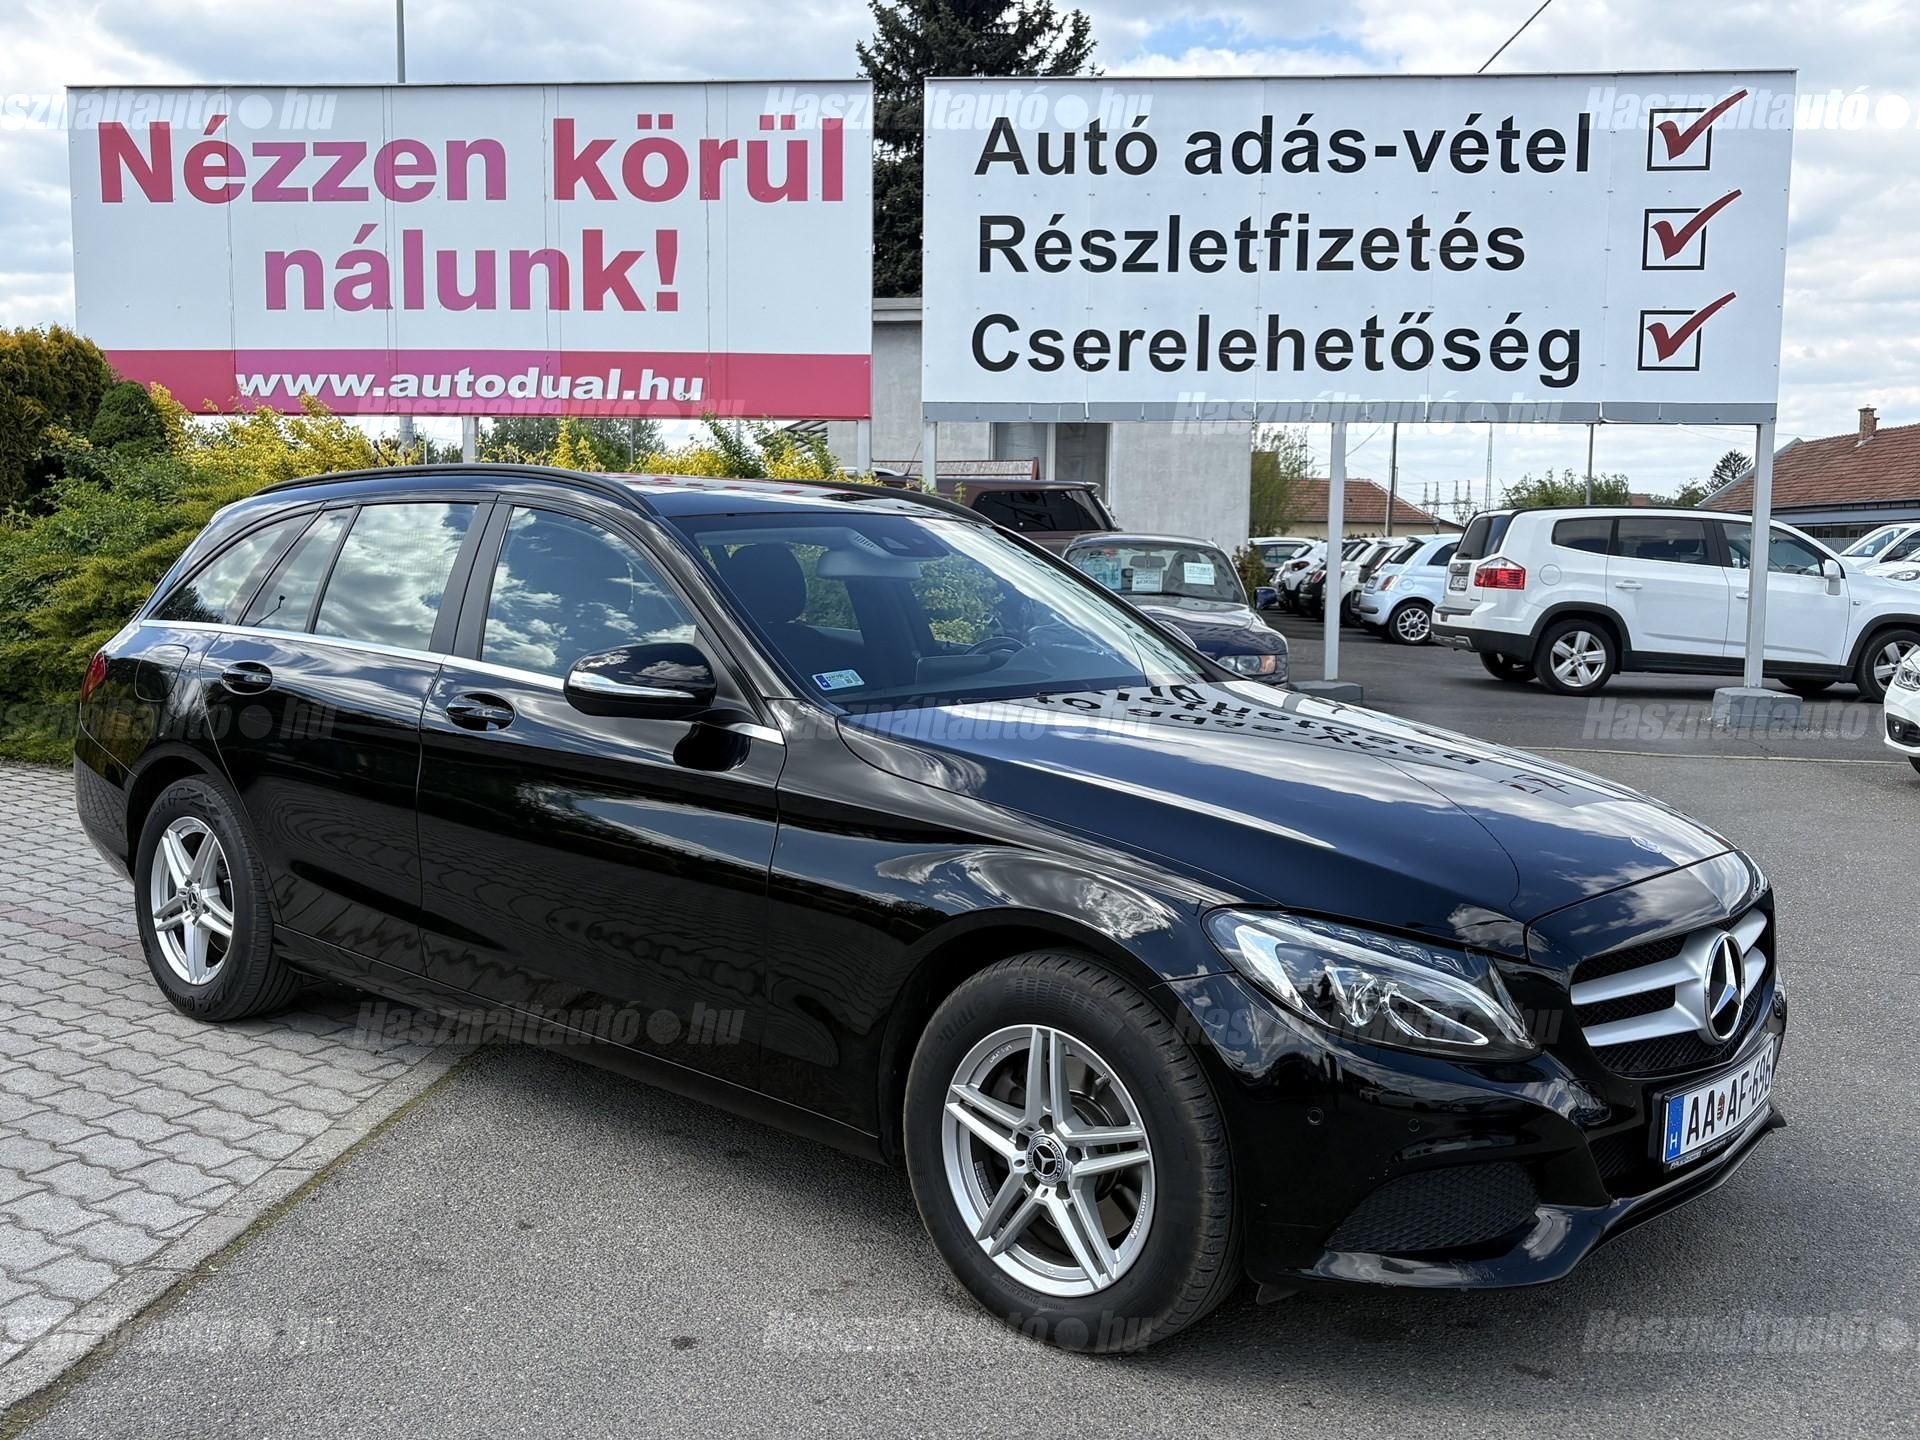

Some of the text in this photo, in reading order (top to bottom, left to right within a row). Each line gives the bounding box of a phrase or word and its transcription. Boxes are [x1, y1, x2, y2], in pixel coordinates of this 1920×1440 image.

[98, 114, 843, 204] Nézzen körül
[974, 112, 1591, 176] Autó adás-vétel
[264, 224, 679, 312] nálunk!
[979, 211, 1526, 274] Részletfizetés
[971, 311, 1581, 388] Cserelehetőség
[235, 366, 703, 402] www.autodual.hu
[1669, 1131, 1679, 1151] H
[1686, 1089, 1716, 1146] AA
